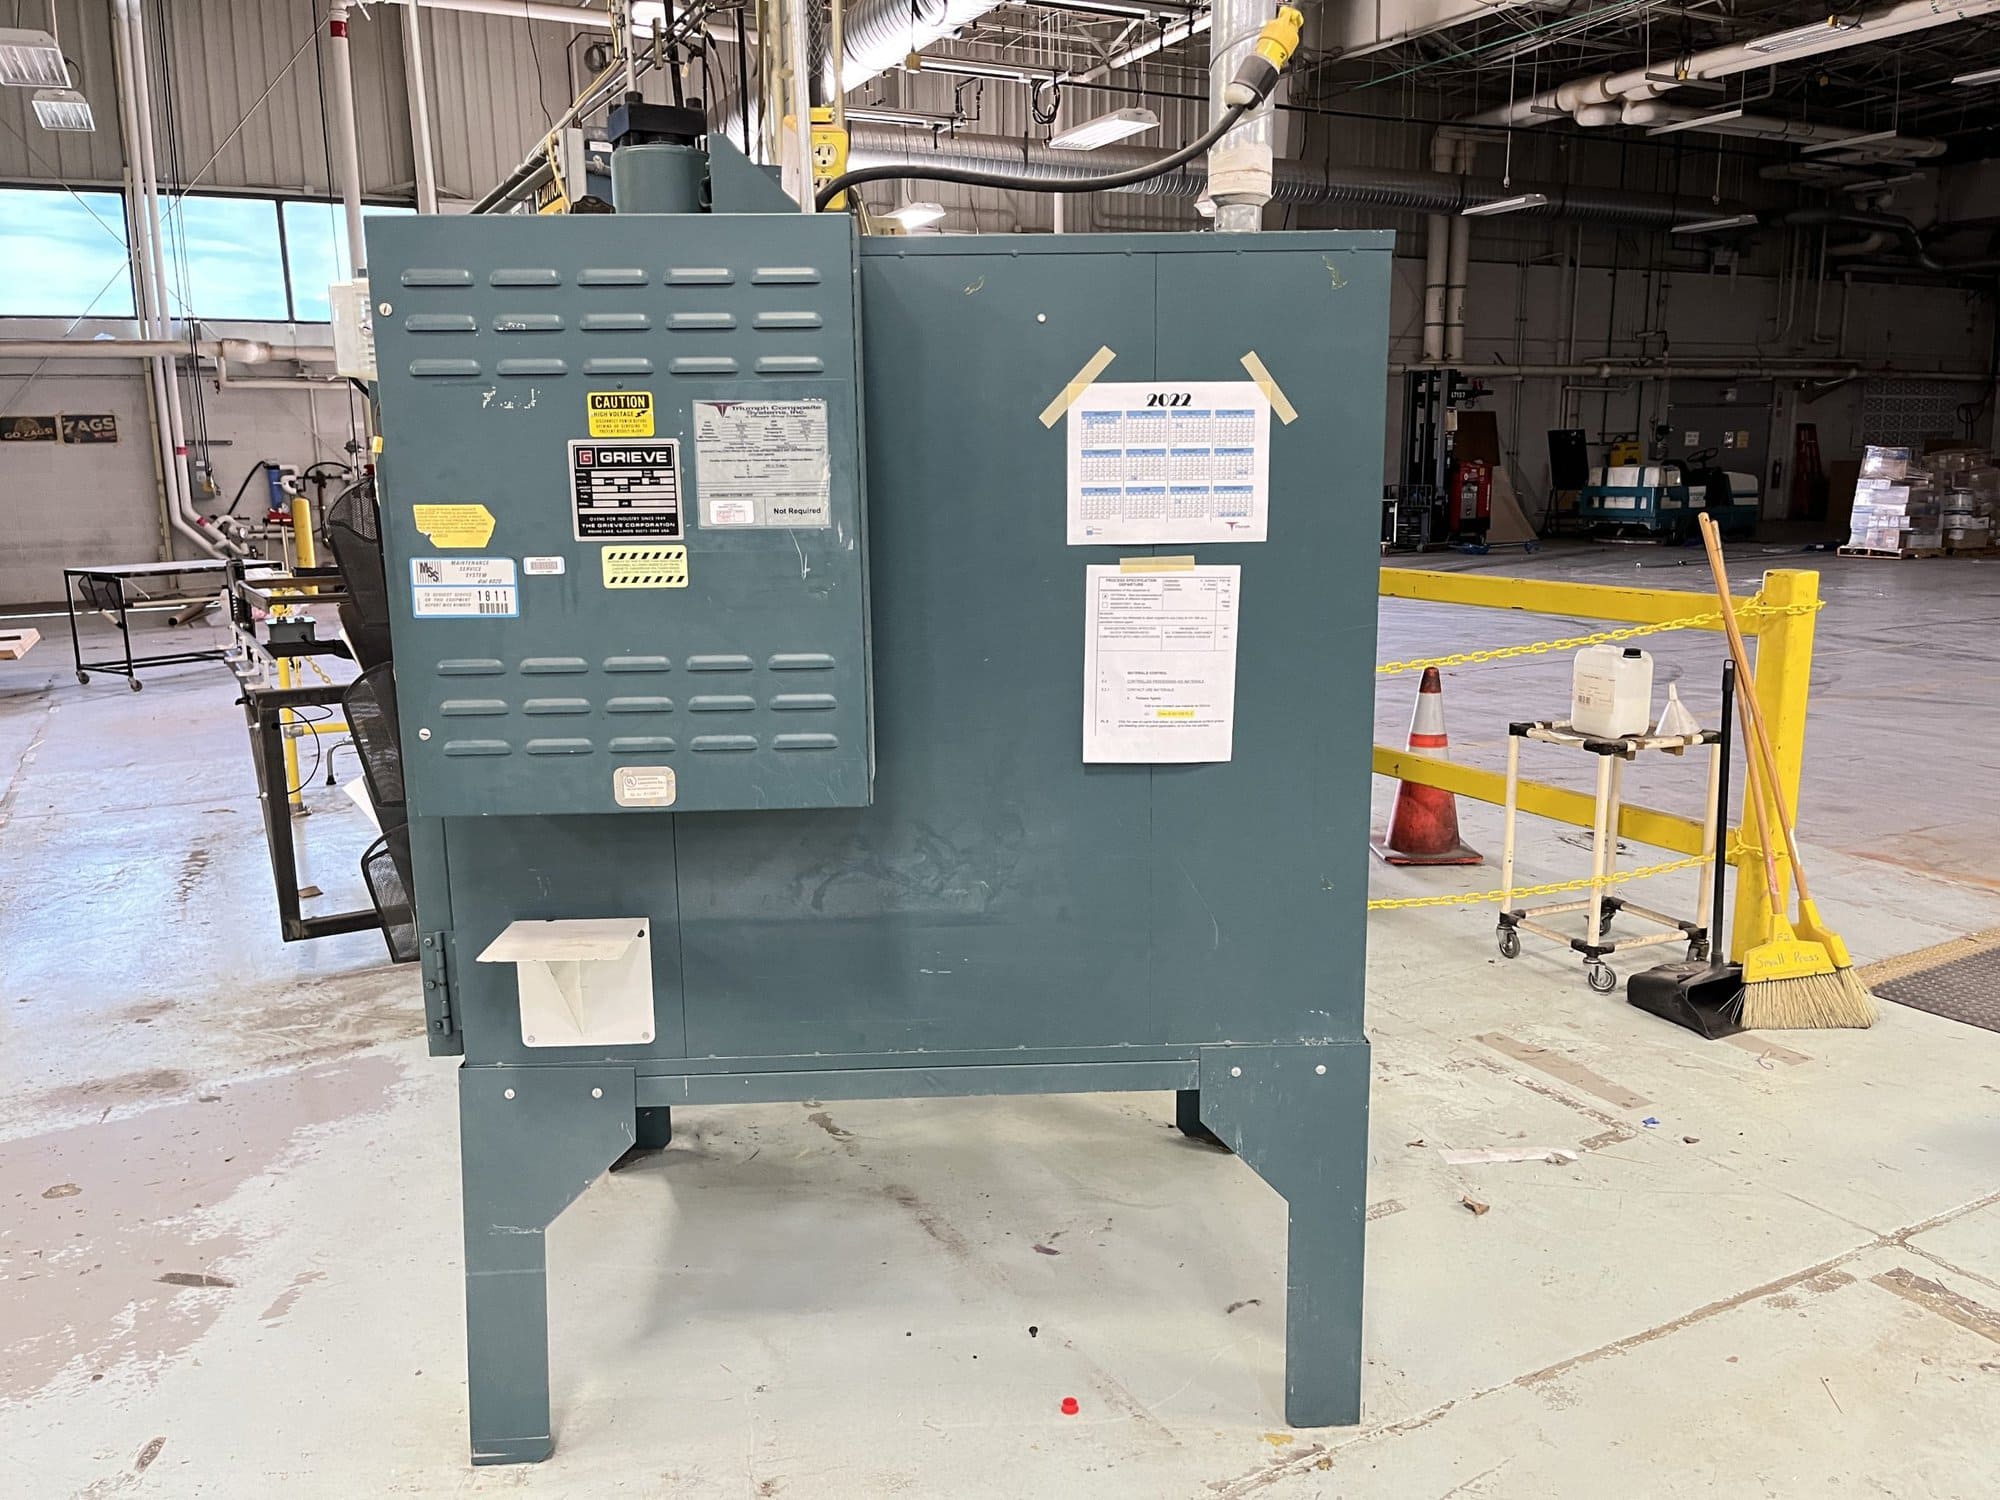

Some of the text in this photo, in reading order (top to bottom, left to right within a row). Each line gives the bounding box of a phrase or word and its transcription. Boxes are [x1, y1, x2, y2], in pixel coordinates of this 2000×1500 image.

[595, 396, 645, 408] CAUTION
[1146, 392, 1192, 407] 2022
[63, 418, 114, 434] ZAGS
[4, 431, 20, 439] GO
[580, 450, 667, 464] G GRIEVE
[789, 507, 821, 516] Required
[478, 590, 507, 602] 1811
[1756, 952, 1819, 968] Small Press
